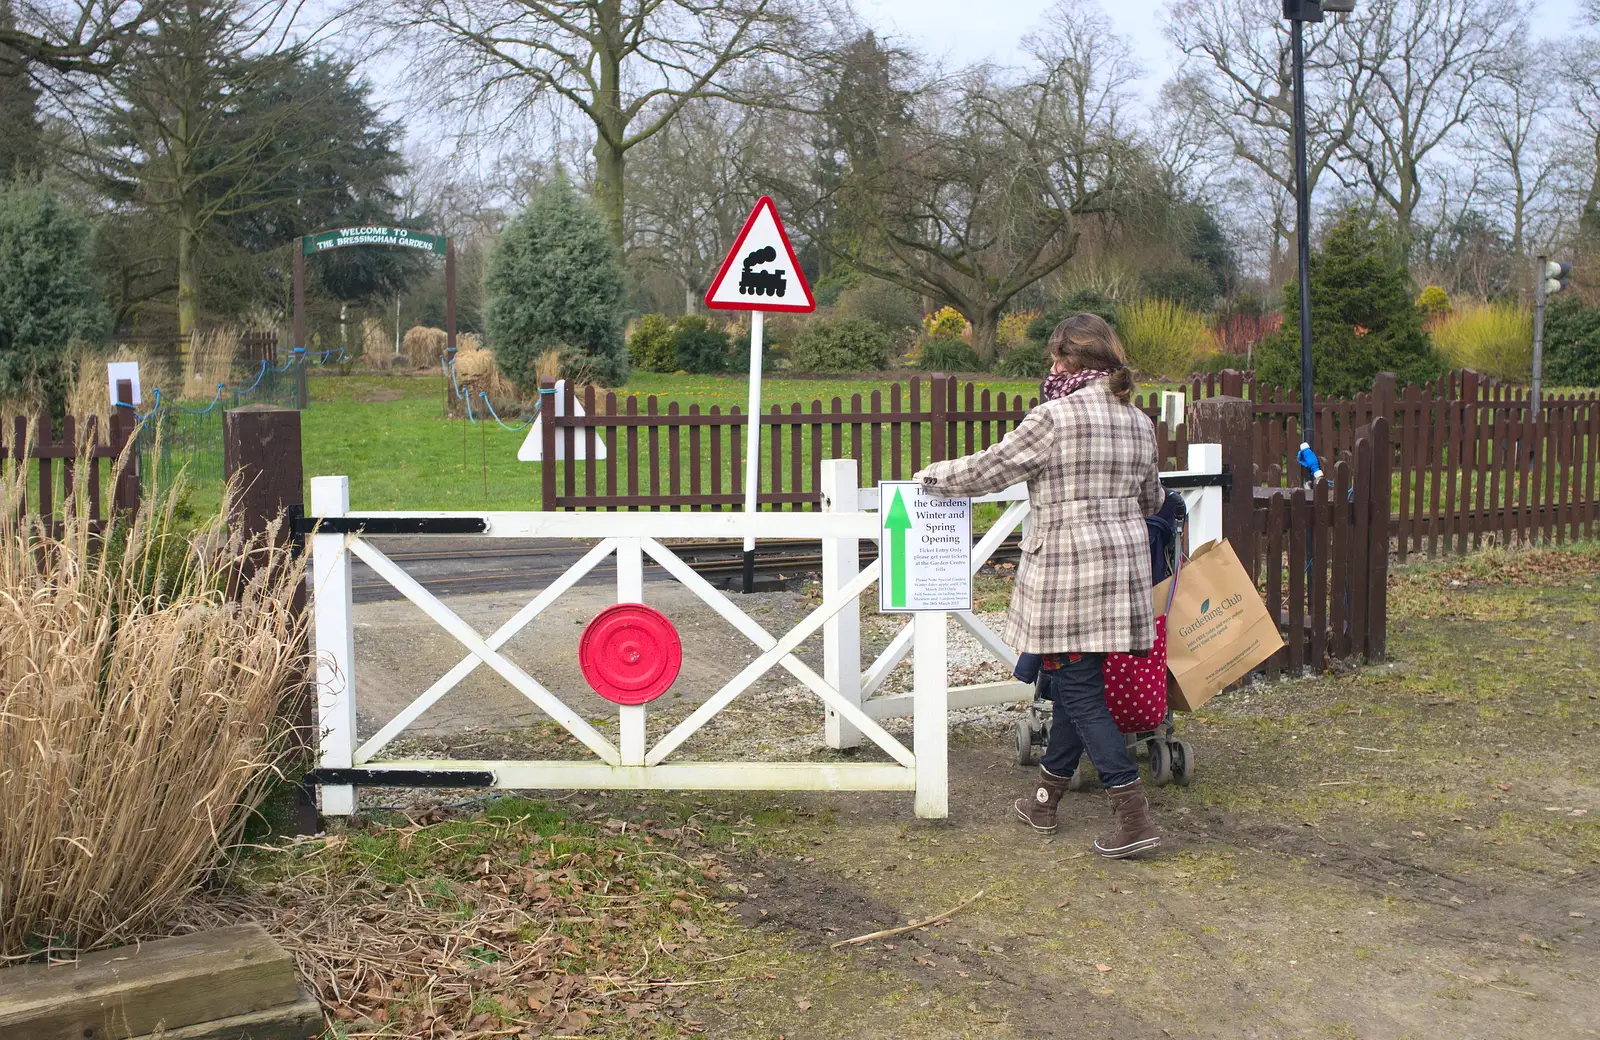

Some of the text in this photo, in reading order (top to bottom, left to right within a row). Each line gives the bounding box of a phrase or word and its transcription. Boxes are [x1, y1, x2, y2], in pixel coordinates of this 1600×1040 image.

[340, 227, 387, 236] WELCOME
[317, 235, 433, 250] THE BRESSINGHAM GARDENS
[926, 523, 955, 532] Spring
[922, 535, 960, 544] Opening
[1178, 593, 1242, 637] Gardening Club
